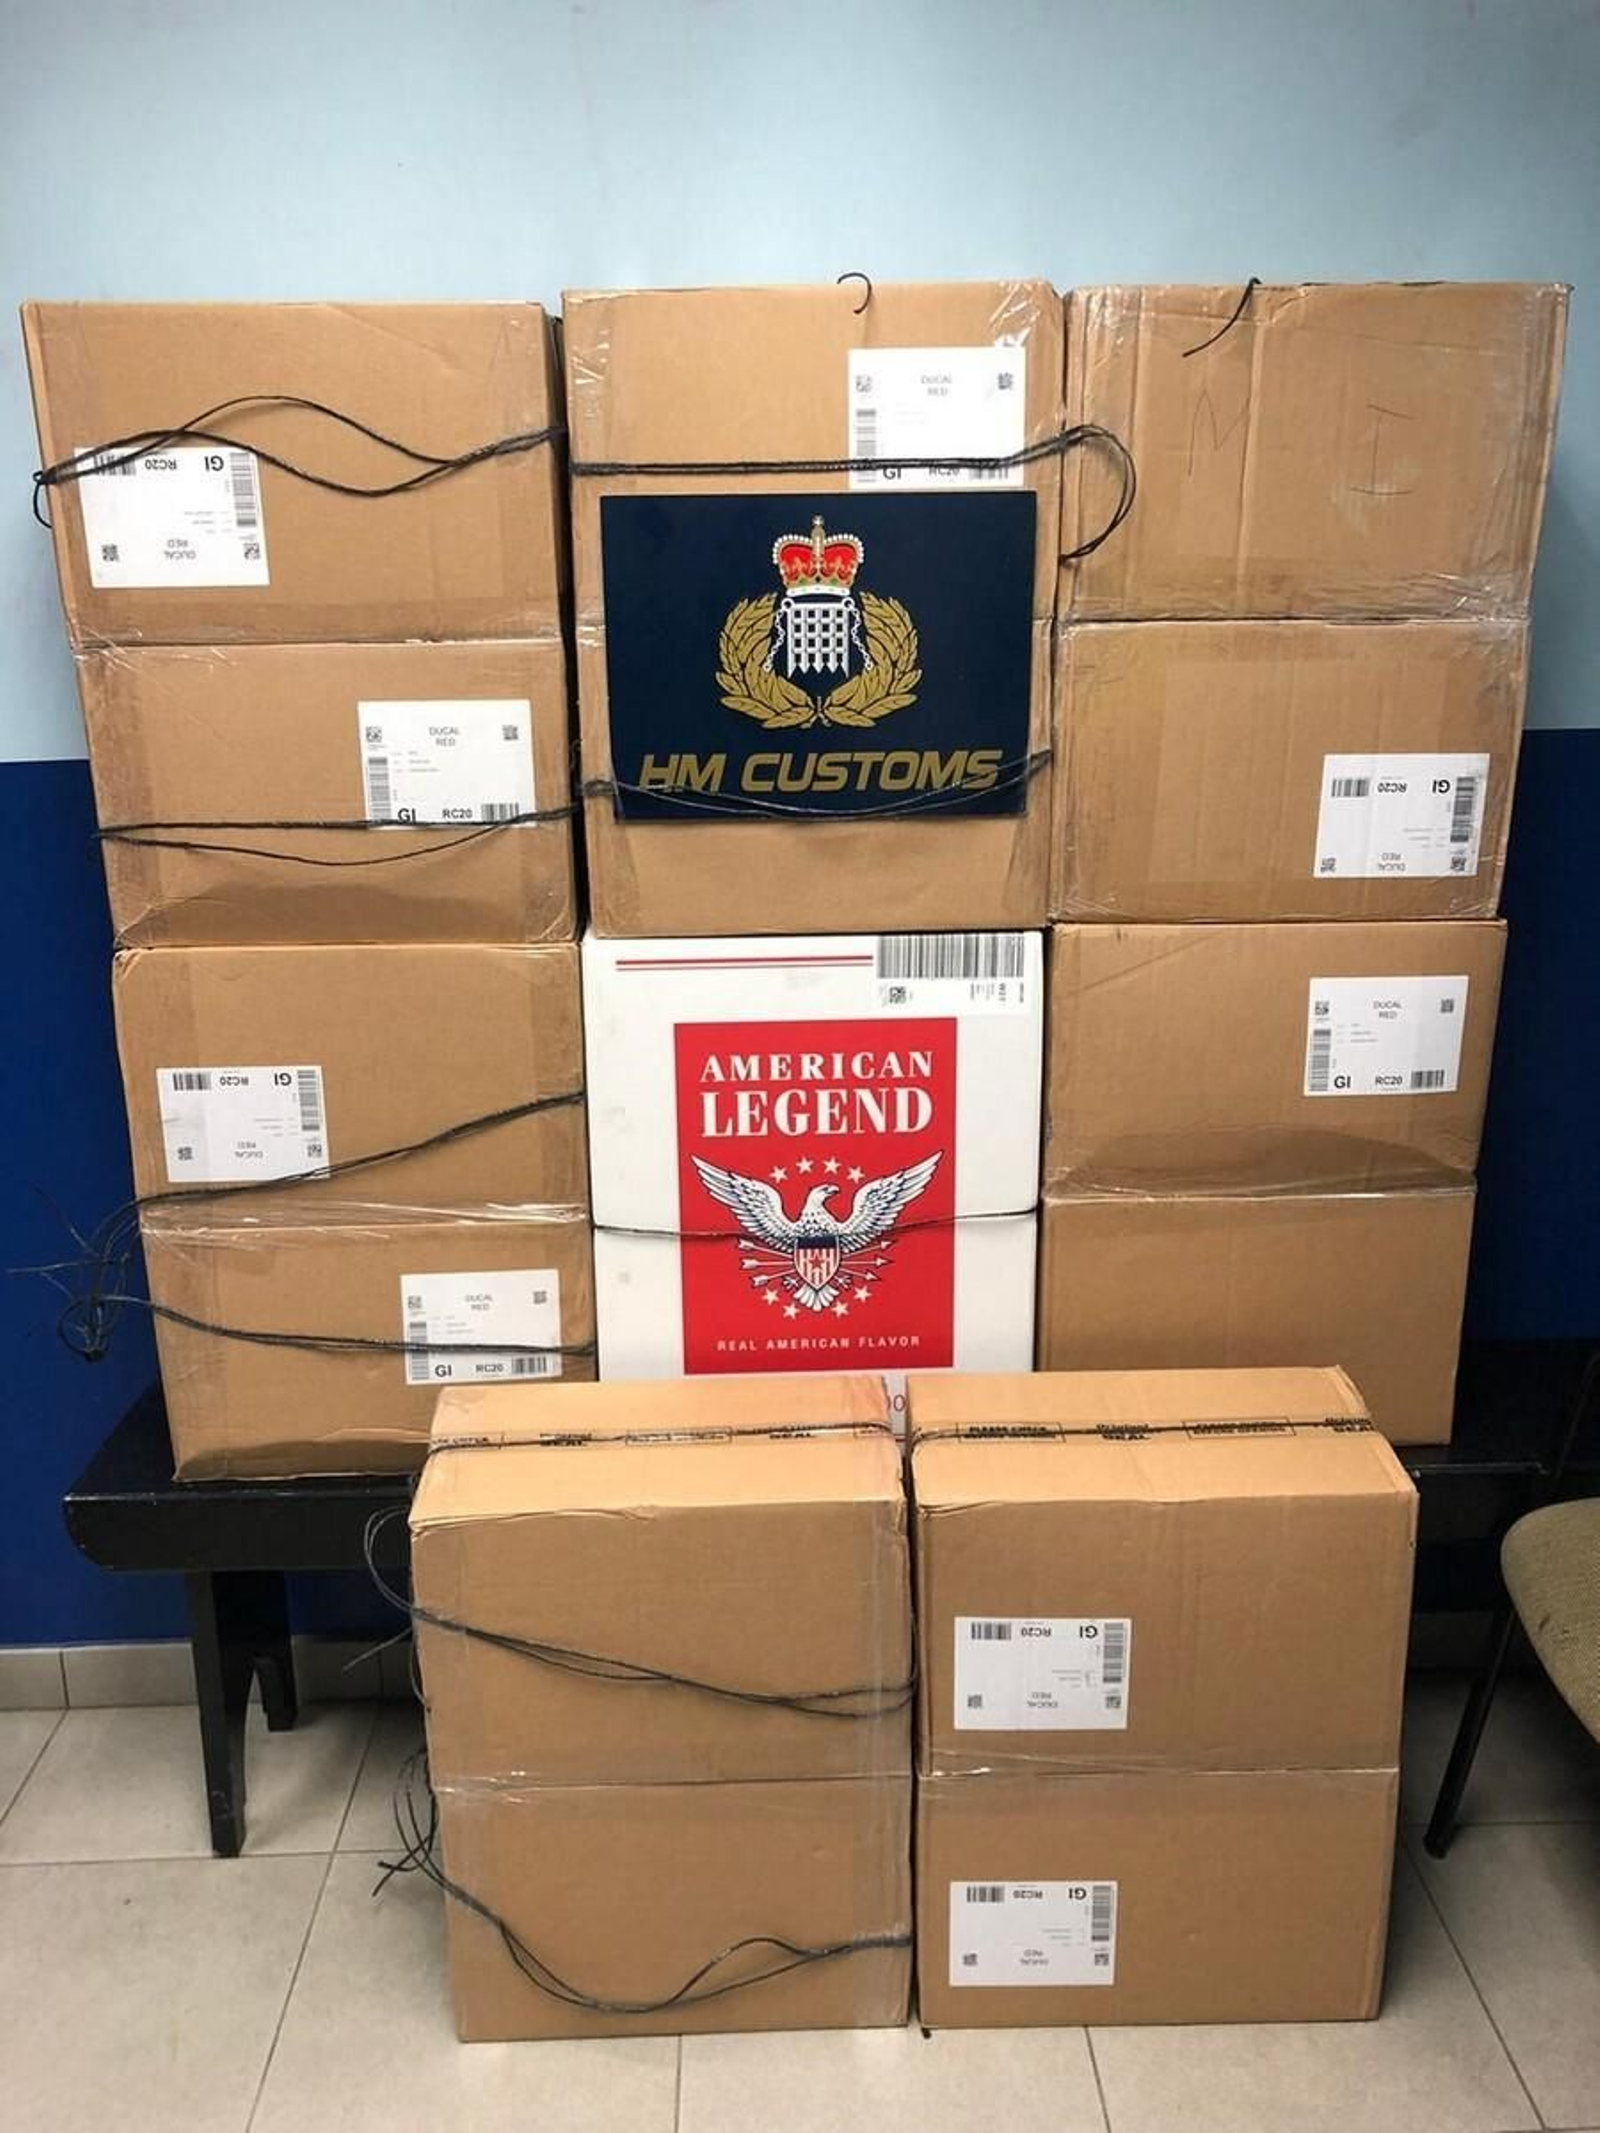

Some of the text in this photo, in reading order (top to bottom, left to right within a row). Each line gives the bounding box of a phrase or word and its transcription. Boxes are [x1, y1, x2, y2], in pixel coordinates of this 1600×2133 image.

[920, 374, 952, 384] DUCAL
[144, 459, 177, 471] RC20
[204, 455, 224, 472] GI
[167, 539, 189, 548] RED
[164, 550, 196, 560] DUCAL
[429, 726, 460, 736] DUCAL
[435, 737, 456, 746] RED
[639, 748, 1003, 795] HM CUSTOMS
[1377, 782, 1408, 793] RC20
[1432, 779, 1451, 794] GI
[397, 808, 417, 824] GI
[442, 808, 473, 819] RC20
[1381, 852, 1401, 861] RED
[1377, 862, 1406, 872] DUCAL
[1373, 1000, 1402, 1009] DUCAL
[1378, 1010, 1398, 1019] RED
[700, 1051, 933, 1082] AMERICAN
[219, 1075, 249, 1087] RC20
[274, 1072, 292, 1087] GI
[1333, 1075, 1352, 1090] GI
[1375, 1075, 1403, 1086] RC20
[701, 1086, 933, 1138] LEGEND
[237, 1141, 257, 1149] RED
[234, 1150, 264, 1159] DUCAL
[465, 1293, 493, 1302] DUCAL
[470, 1303, 490, 1311] RED
[717, 1334, 921, 1352] REAL AMERICAN FLAVOR
[434, 1364, 453, 1378] GI
[475, 1363, 505, 1374] RC20
[1021, 1627, 1051, 1638] RC20
[1079, 1625, 1098, 1639] GI
[1031, 1691, 1052, 1699] RED
[1027, 1700, 1059, 1709] DUCAL
[1012, 1889, 1043, 1900] RC20
[1068, 1887, 1087, 1901] GI
